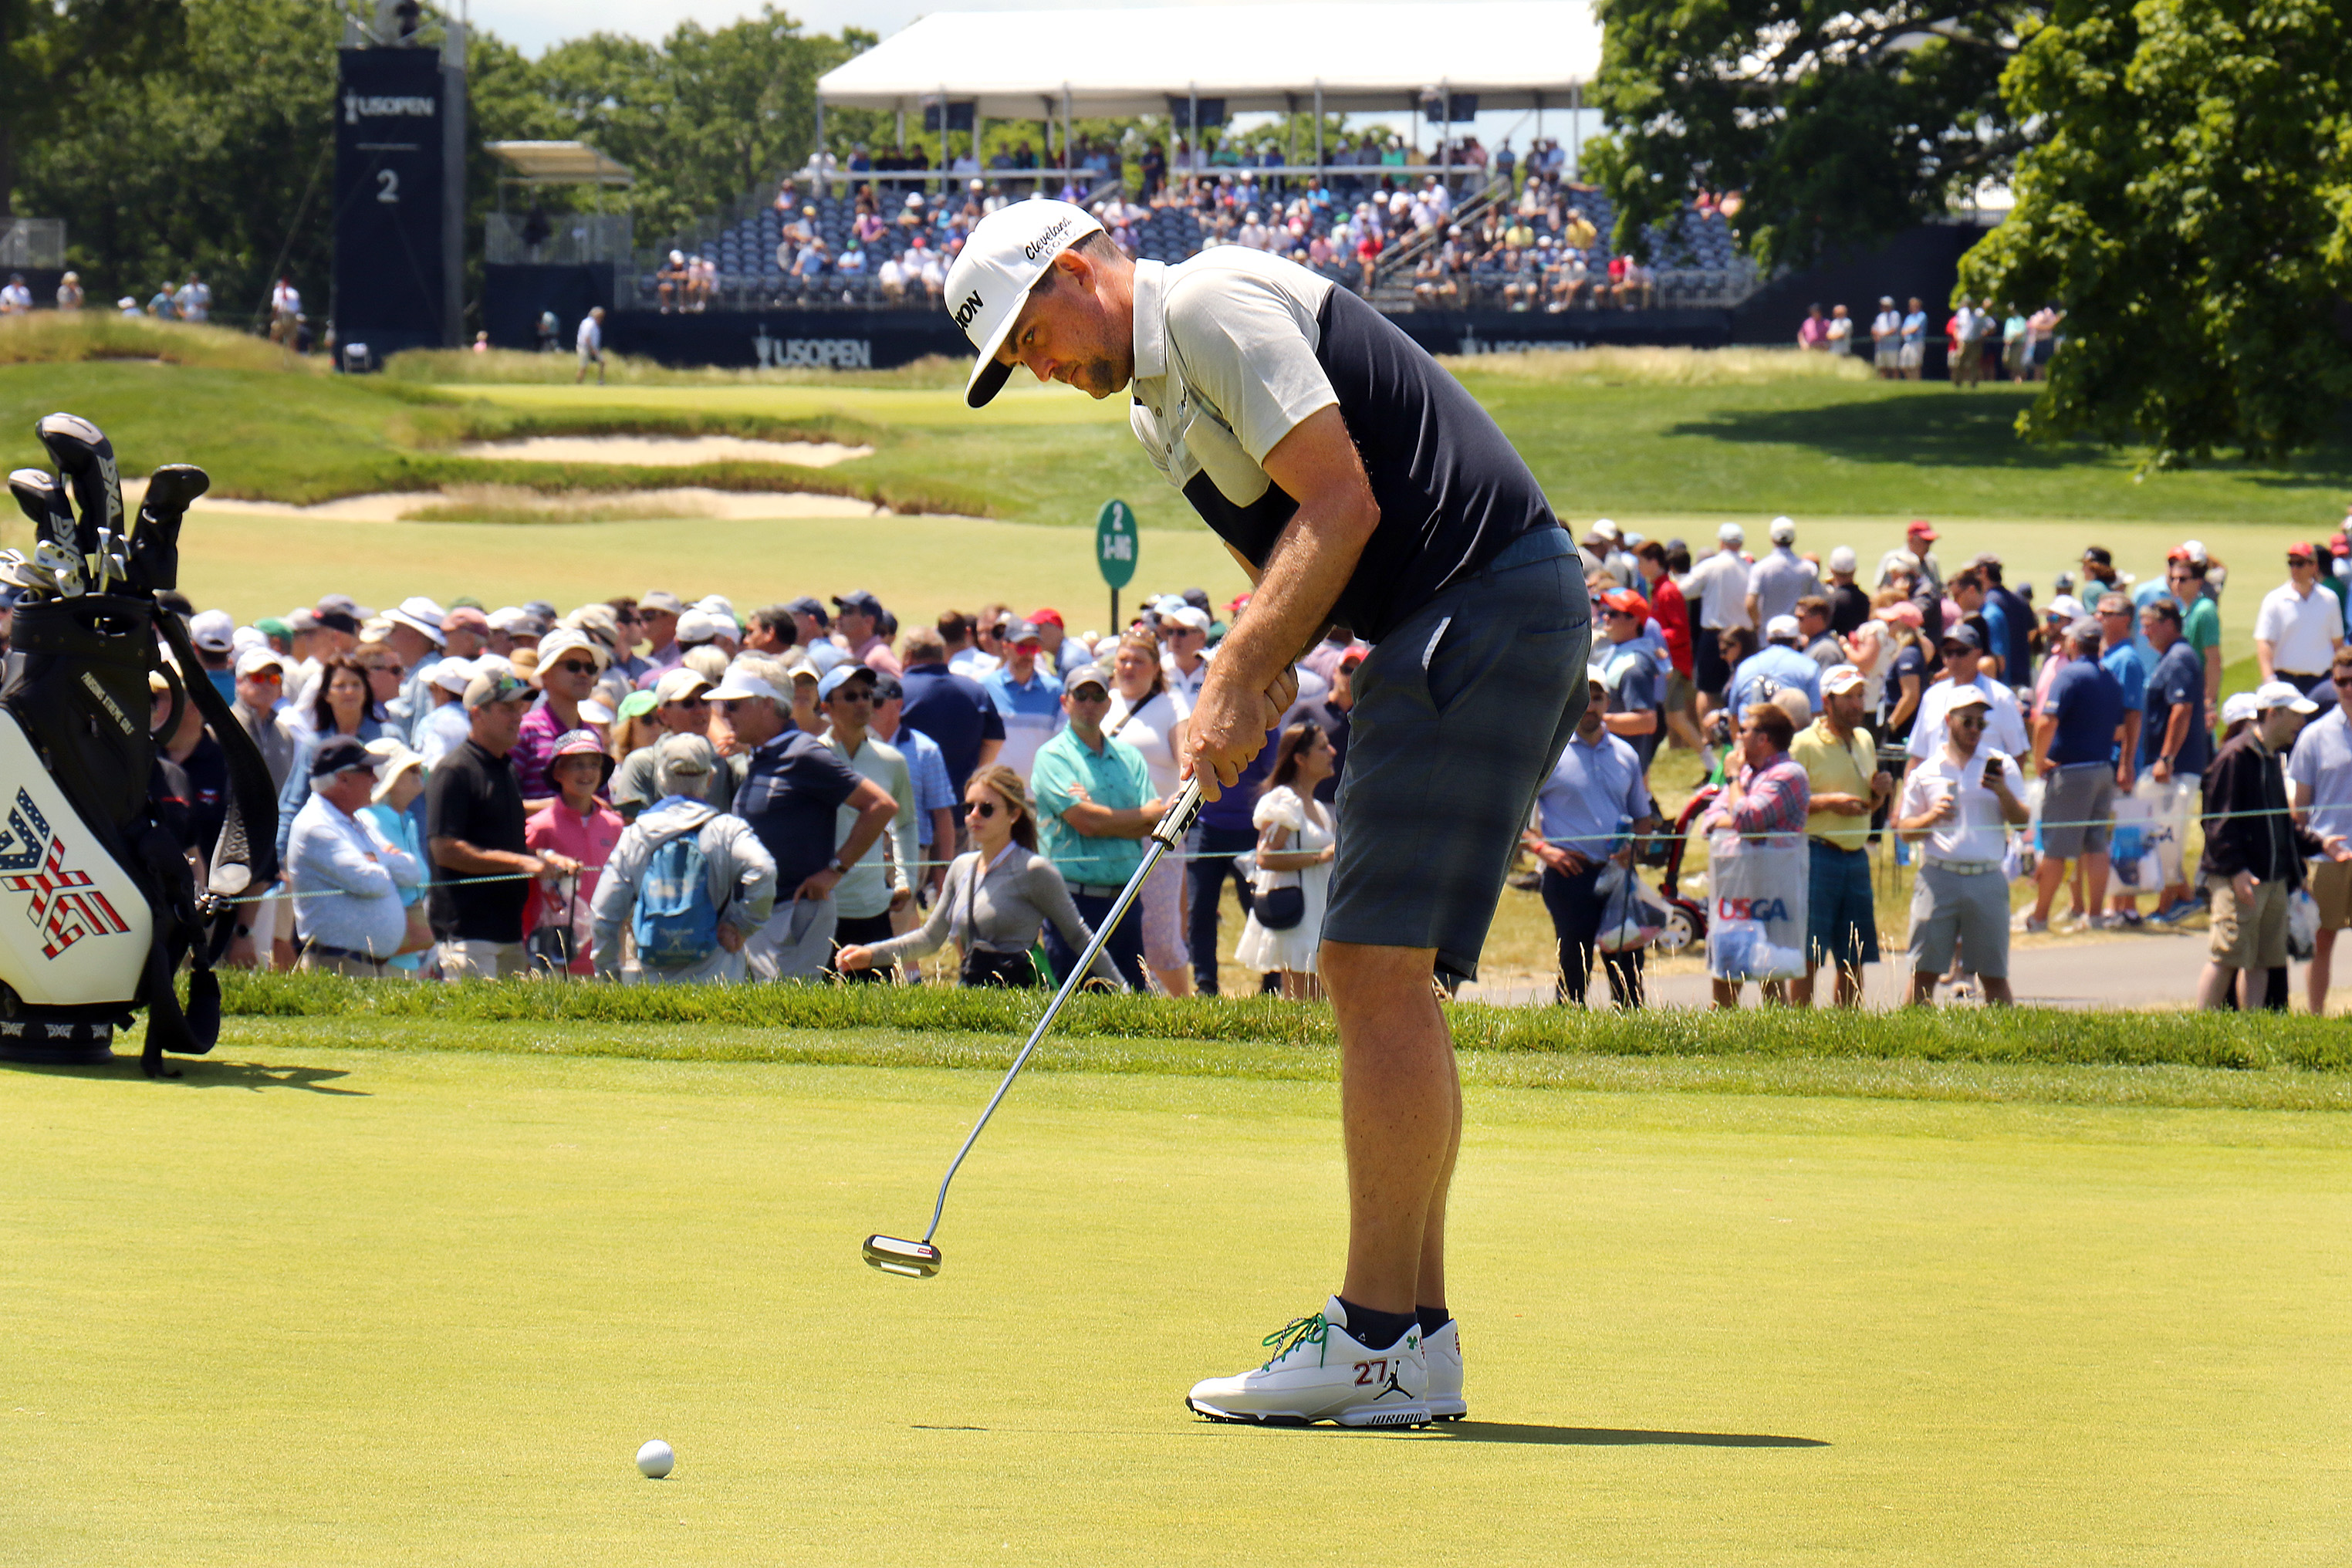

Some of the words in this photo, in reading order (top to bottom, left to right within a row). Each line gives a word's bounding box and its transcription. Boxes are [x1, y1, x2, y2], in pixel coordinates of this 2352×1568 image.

[377, 167, 400, 203] 2
[1026, 216, 1071, 259] Cleveland
[773, 338, 871, 367] USOPEN
[1112, 502, 1124, 532] 2
[1718, 897, 1789, 921] USGA
[1353, 1358, 1387, 1387] 27
[1367, 1412, 1423, 1425] JORDAN
